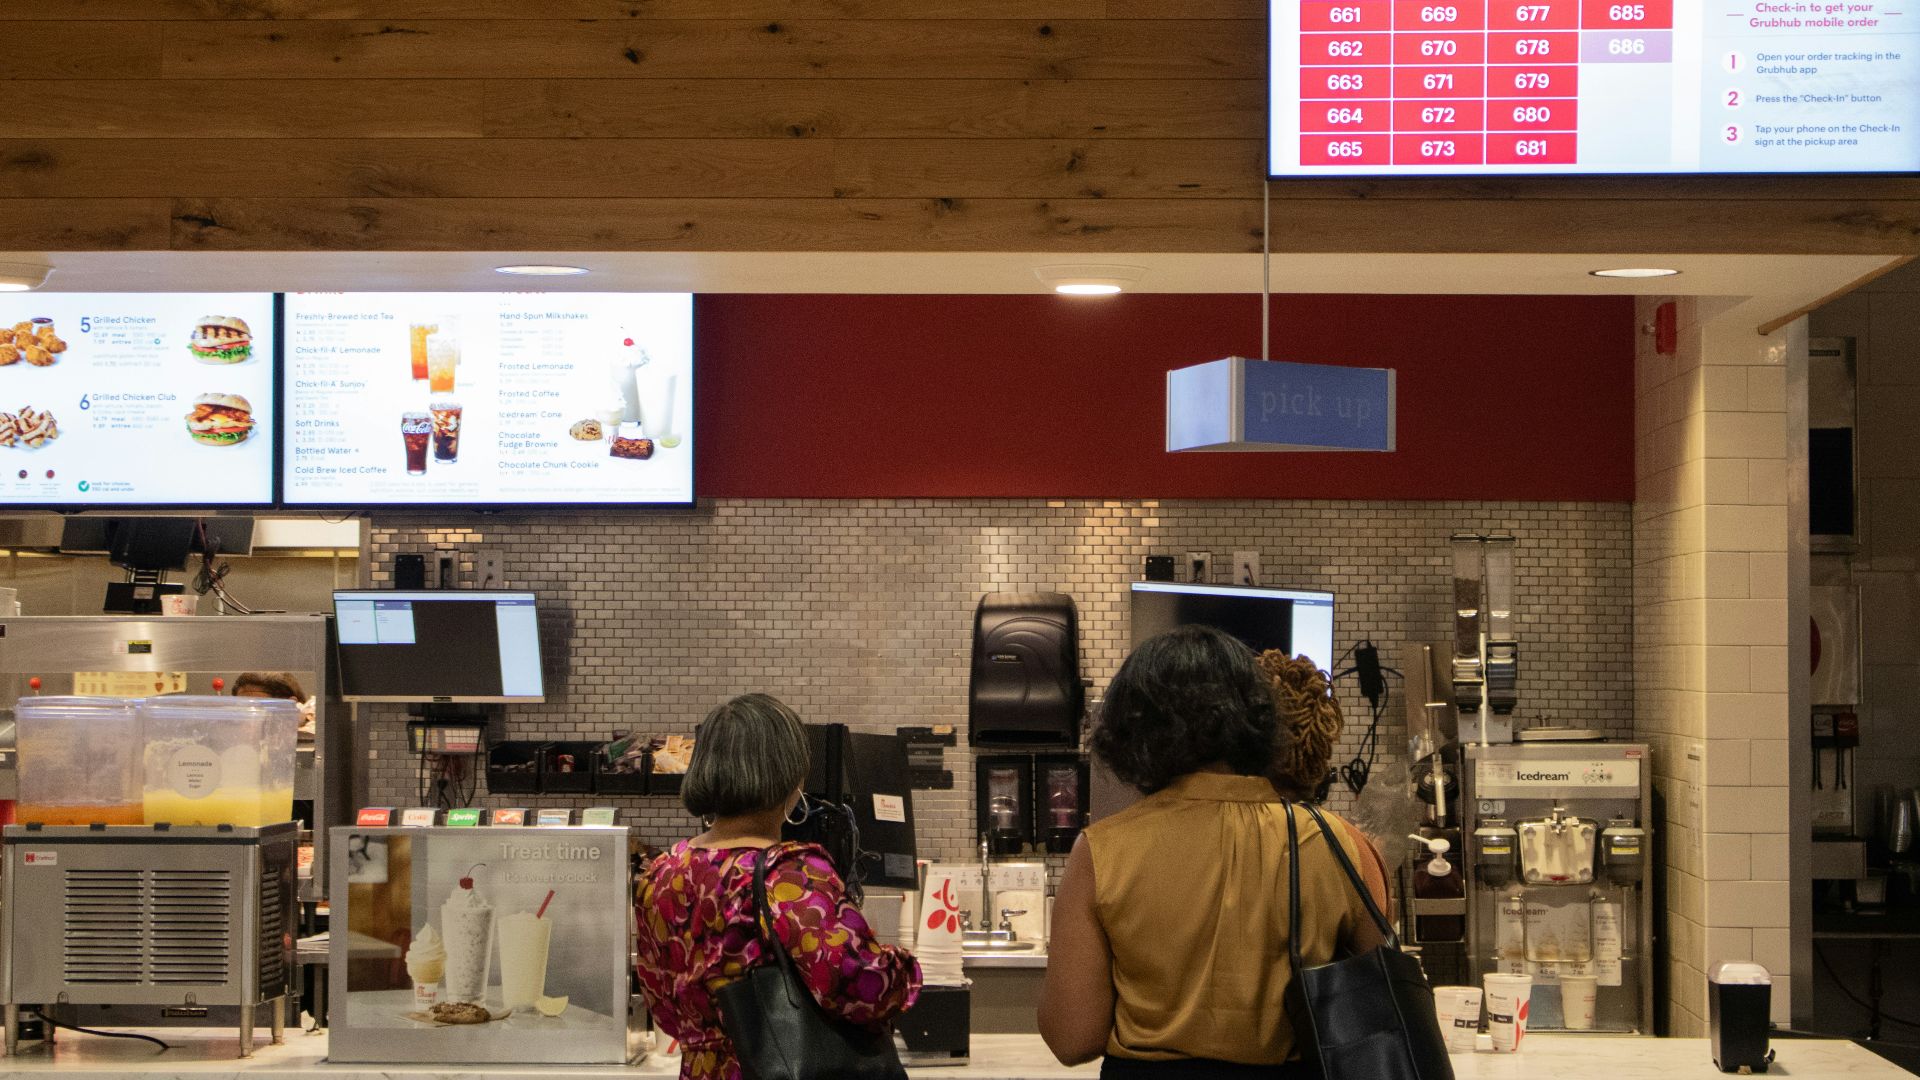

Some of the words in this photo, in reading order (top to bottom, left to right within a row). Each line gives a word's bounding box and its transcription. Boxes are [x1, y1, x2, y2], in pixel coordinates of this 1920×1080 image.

[1330, 7, 1360, 22] 661
[1421, 6, 1458, 22] 669
[1516, 6, 1550, 22] 677
[1609, 5, 1645, 20] 685
[1756, 2, 1806, 12] Check-in
[1810, 2, 1822, 12] to
[1825, 3, 1844, 14] get
[1848, 4, 1874, 14] your
[1750, 17, 1801, 28] Grubhub
[1805, 17, 1844, 27] mobile
[1848, 17, 1878, 27] order
[1328, 41, 1363, 56] 662
[1421, 40, 1456, 56] 670
[1515, 40, 1550, 55] 678
[1608, 39, 1645, 54] 686
[1731, 54, 1736, 69] 1
[1756, 53, 1782, 62] Open
[1784, 54, 1804, 62] your
[1808, 52, 1832, 61] order
[1834, 52, 1872, 62] tracking
[1875, 52, 1884, 60] in
[1886, 52, 1900, 60] the
[1756, 66, 1798, 74] Grubhub
[1800, 67, 1818, 75] app
[1328, 74, 1363, 90] 663
[1424, 74, 1453, 90] 671
[1515, 74, 1550, 88] 679
[1728, 91, 1739, 106] 2
[1756, 95, 1780, 103] Press
[1327, 108, 1364, 124] 664
[1422, 108, 1455, 123] 672
[1512, 107, 1550, 122] 680
[1726, 126, 1738, 142] 3
[1755, 125, 1772, 134] Tap
[1774, 126, 1794, 134] your
[1796, 124, 1826, 134] phone
[1842, 124, 1857, 132] the
[1860, 124, 1900, 132] Check-In
[1328, 142, 1363, 156] 665
[1421, 141, 1456, 156] 673
[1516, 140, 1546, 156] 681
[1755, 138, 1774, 146] sign
[1804, 138, 1836, 146] pickup
[122, 316, 156, 324] Chicken
[546, 312, 588, 320] Milkshakes
[80, 316, 91, 333] 5
[499, 390, 530, 398] Frosted
[532, 390, 560, 398] Coffee
[80, 394, 90, 410] 6
[1260, 384, 1321, 422] pick
[1337, 396, 1371, 428] up
[295, 420, 312, 428] Soft
[314, 420, 340, 428] Drinks
[498, 440, 523, 449] Fudge
[1516, 771, 1569, 781] Icedream
[451, 813, 477, 822] Sprite
[500, 842, 550, 860] Treat
[557, 842, 601, 860] time
[1503, 906, 1546, 915] Icedeam
